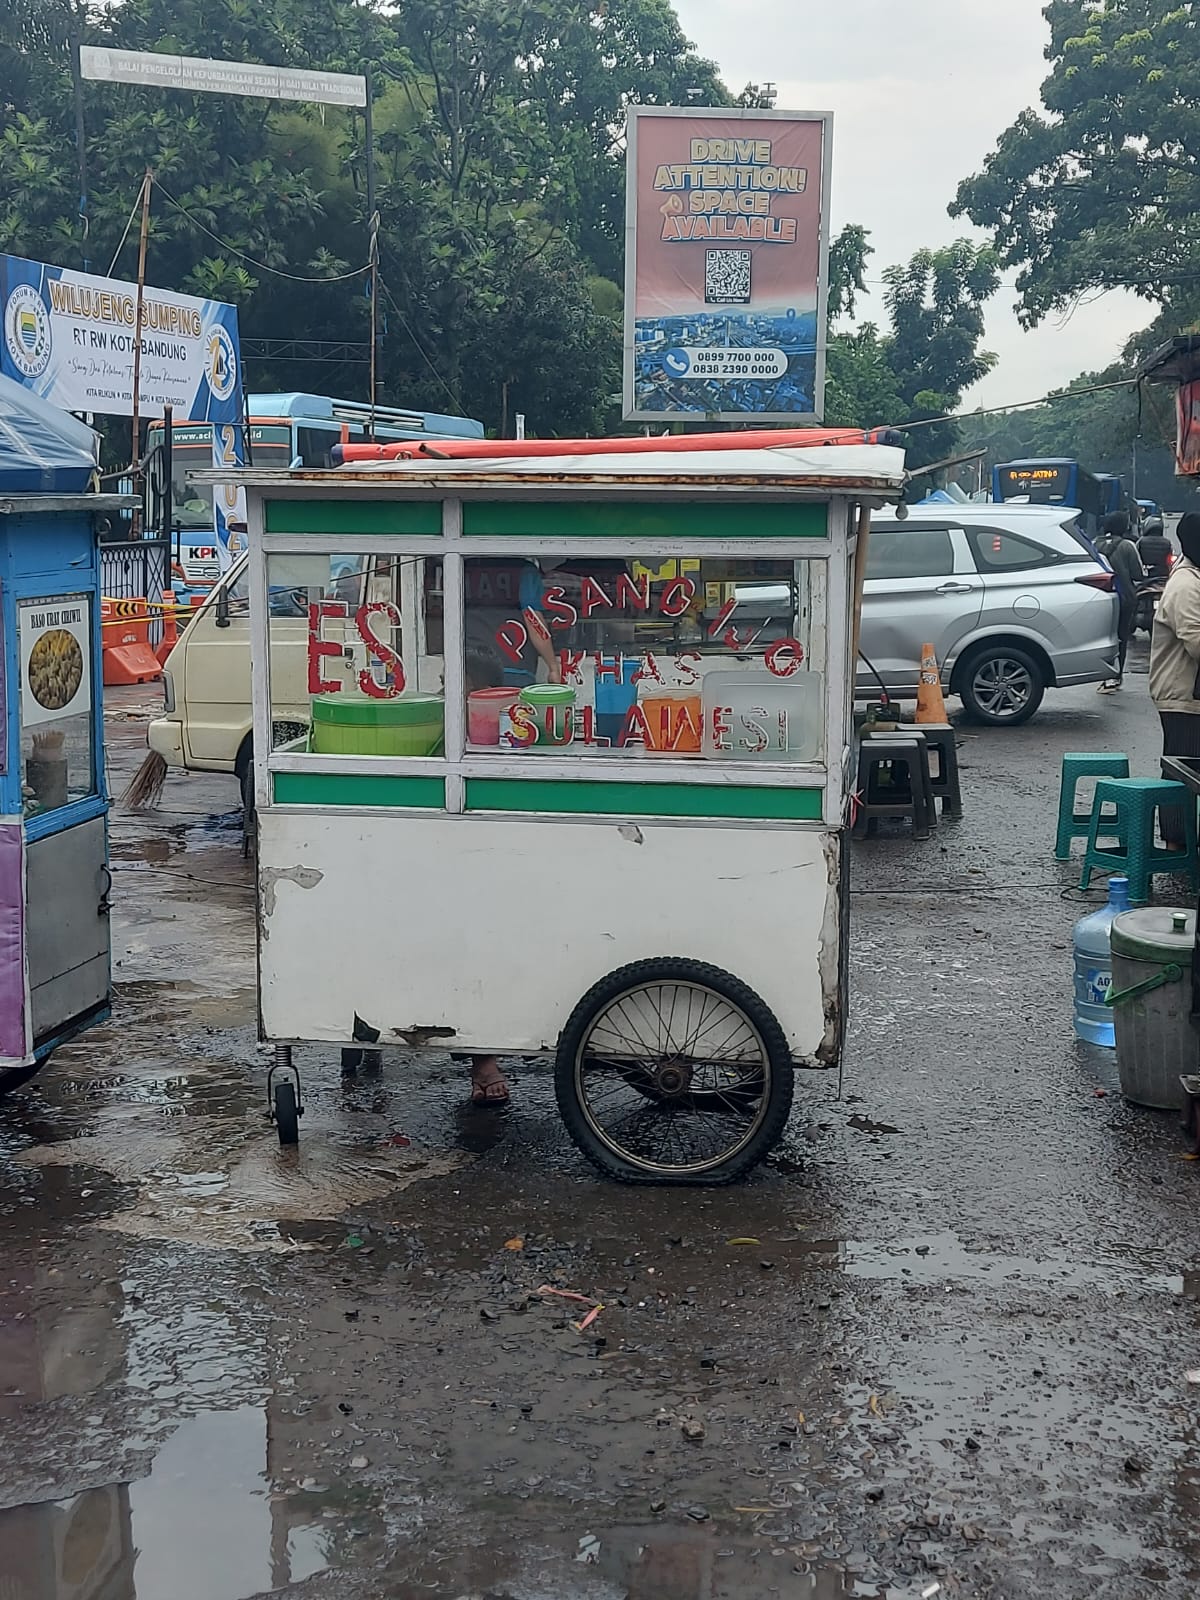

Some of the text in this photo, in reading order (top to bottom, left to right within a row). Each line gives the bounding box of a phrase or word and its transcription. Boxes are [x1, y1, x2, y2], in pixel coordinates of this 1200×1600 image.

[691, 139, 771, 164] DRIVE
[653, 165, 807, 192] ATTENTION!
[689, 190, 770, 215] SPACE
[661, 215, 798, 244] AVAILABLE
[49, 281, 202, 338] WILUJENG SUMPING
[73, 328, 187, 361] RT RW KOTA BANDUNG
[697, 352, 775, 362] 0899 7700 000
[693, 364, 779, 374] 0838 2390 0000
[30, 613, 45, 629] BASO
[496, 573, 696, 662] PISANG
[307, 600, 407, 700] ES
[560, 650, 703, 687] KHAS
[507, 703, 789, 752] SULAWESI
